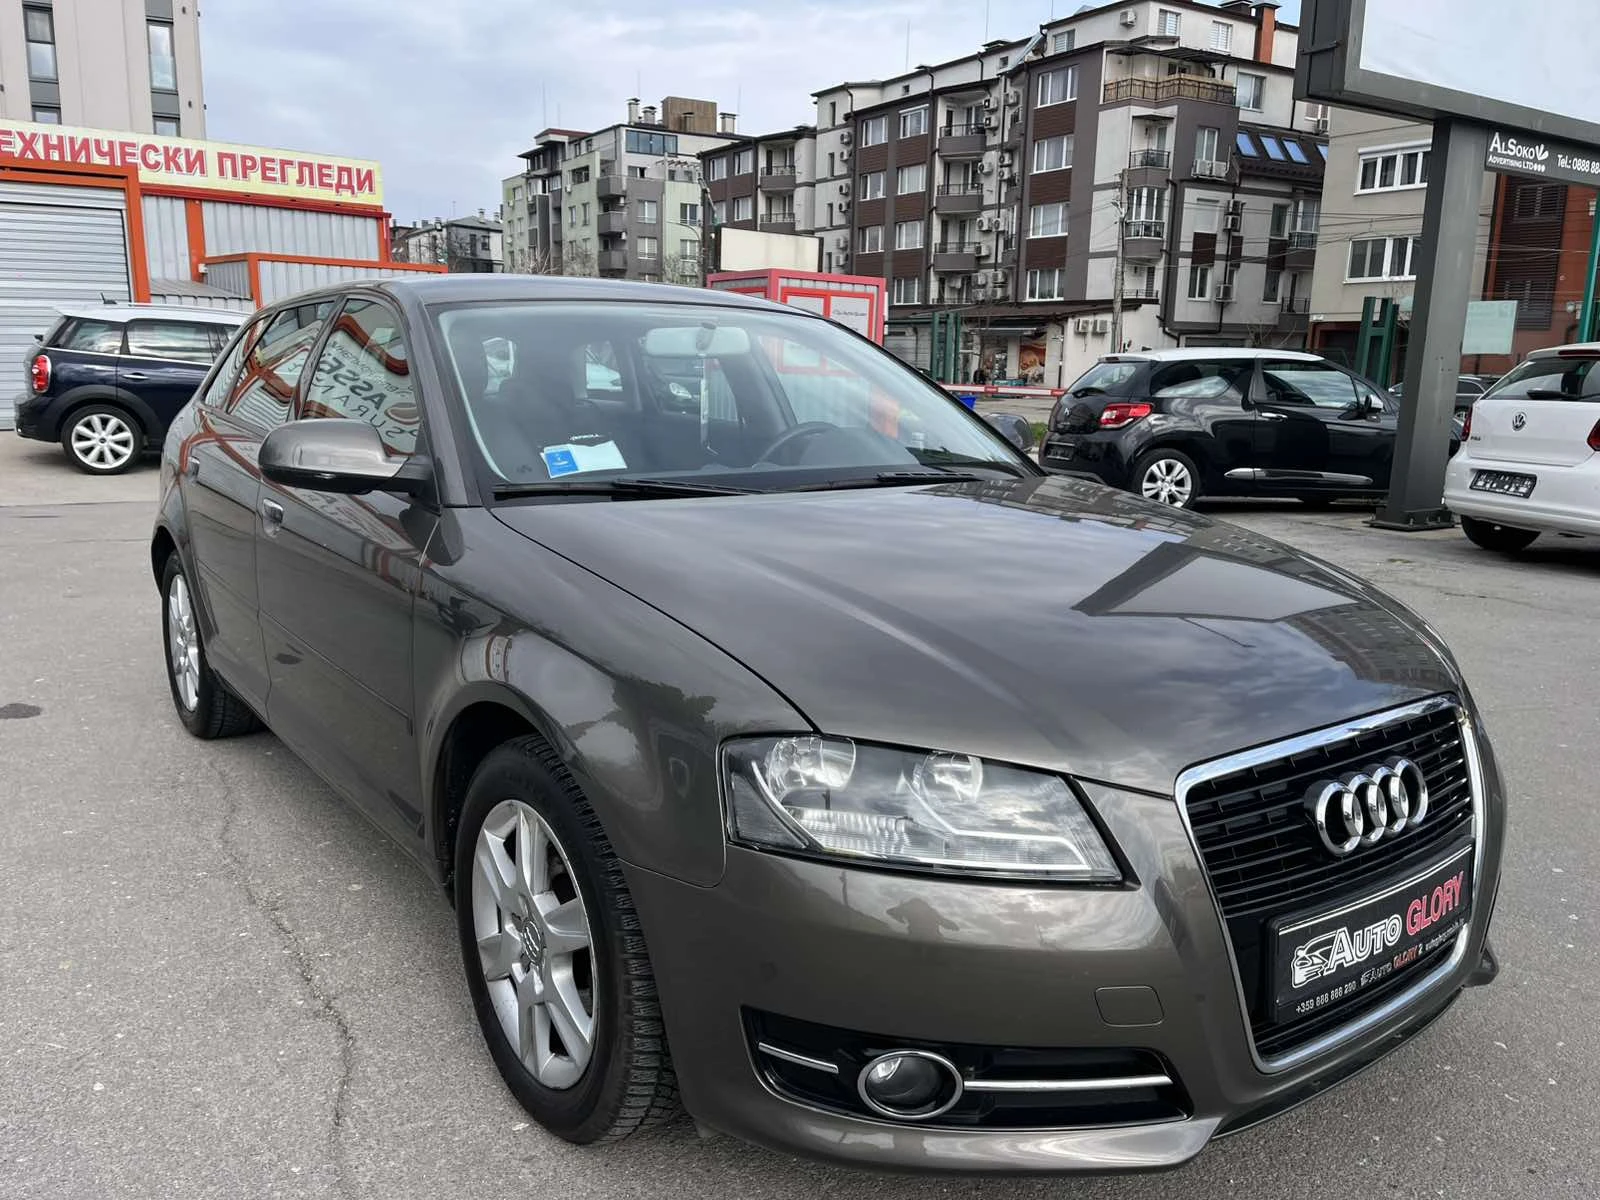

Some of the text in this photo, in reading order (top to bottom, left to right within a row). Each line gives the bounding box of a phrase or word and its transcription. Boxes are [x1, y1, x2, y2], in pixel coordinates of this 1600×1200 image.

[217, 151, 376, 195] ПРЕГЛЕДИ
[1488, 155, 1534, 170] ADVERTISING LTD
[1572, 157, 1590, 172] 0888
[1406, 870, 1464, 936] GLORY
[1296, 999, 1314, 1013] +359
[1316, 992, 1329, 1006] 888
[1330, 986, 1343, 1000] 888
